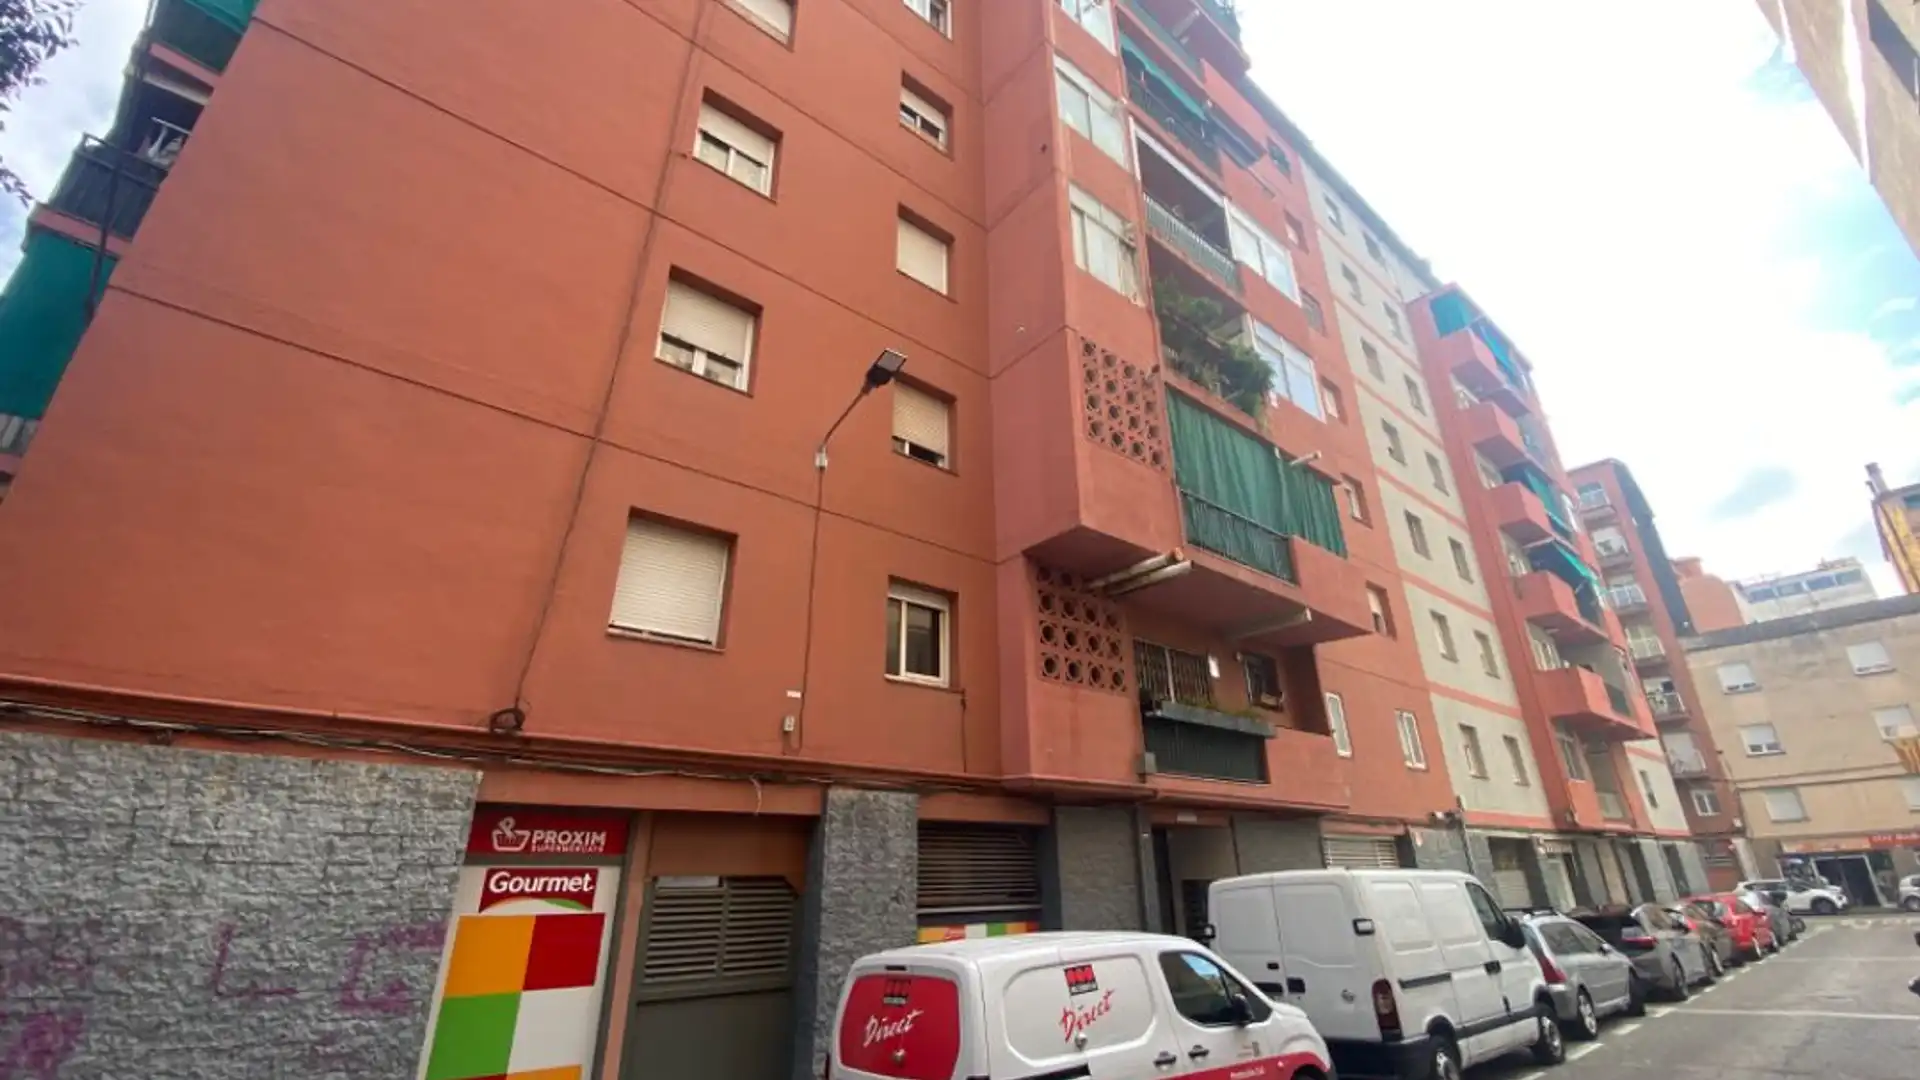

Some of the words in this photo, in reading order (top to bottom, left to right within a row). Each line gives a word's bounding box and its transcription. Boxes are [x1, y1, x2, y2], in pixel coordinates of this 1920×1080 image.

[531, 829, 607, 845] PROXIM
[489, 871, 595, 894] Gourmet
[863, 1009, 924, 1048] Direct
[1058, 987, 1116, 1043] Direct
